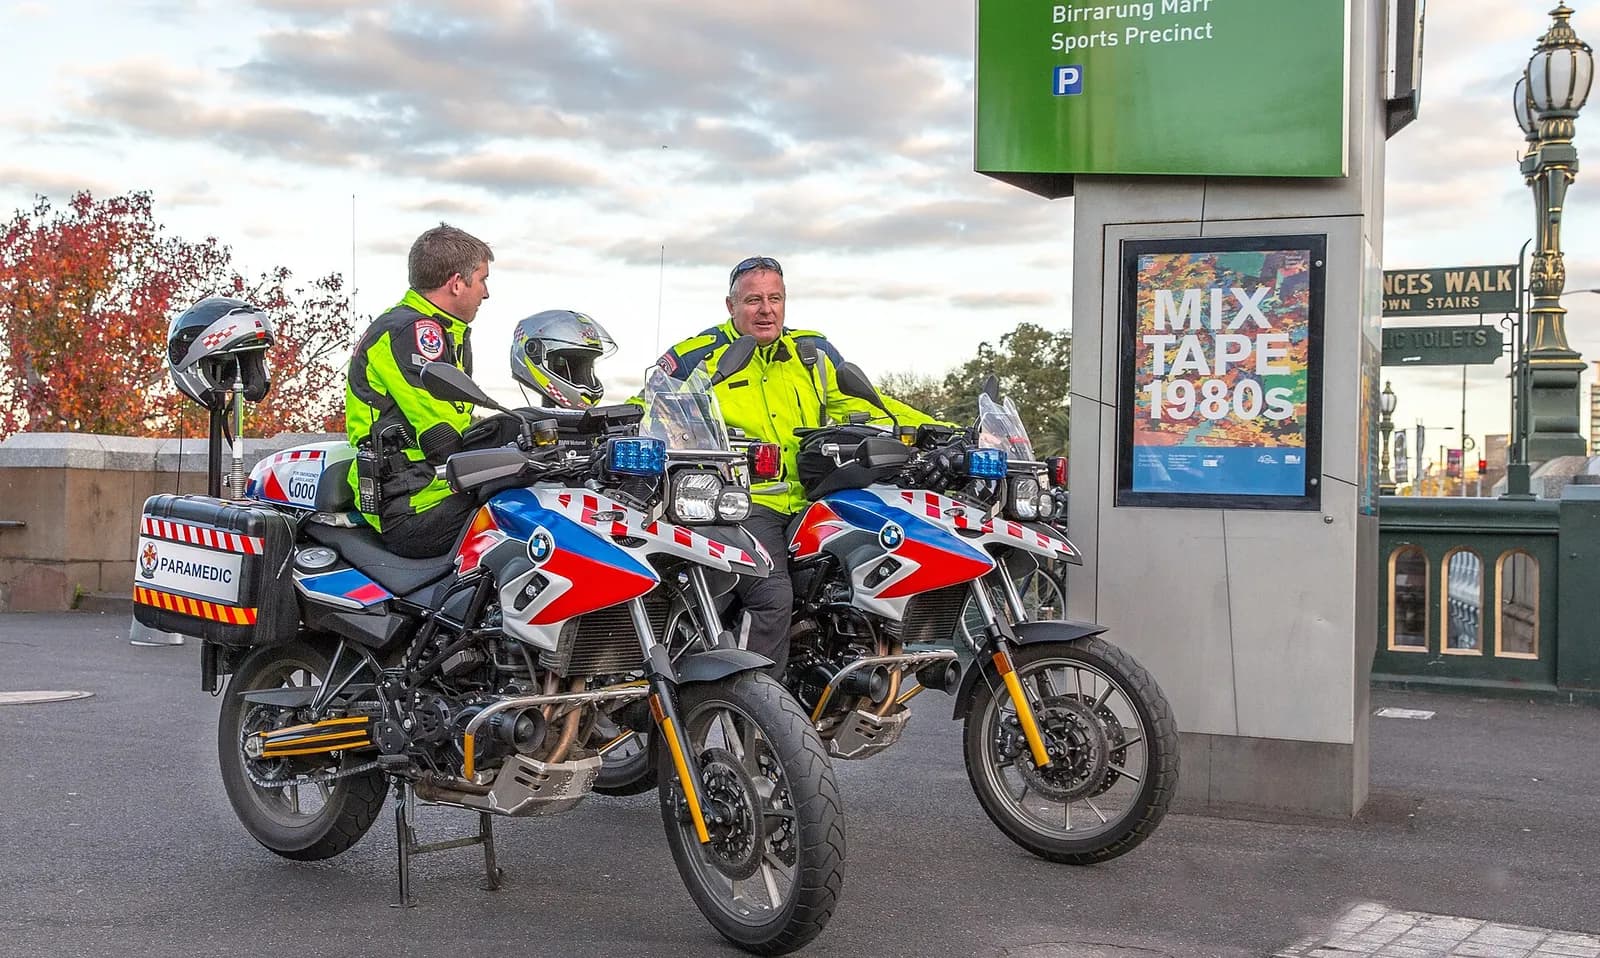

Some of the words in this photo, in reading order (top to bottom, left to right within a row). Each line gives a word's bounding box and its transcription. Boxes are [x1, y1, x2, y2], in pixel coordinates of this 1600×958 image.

[1052, 2, 1153, 24] Birrarung
[1161, 0, 1212, 15] Marr
[1051, 30, 1118, 54] Sports
[1125, 22, 1213, 45] Precinct
[1058, 67, 1079, 94] P
[1445, 269, 1512, 293] WALK
[1154, 286, 1273, 330] MIX
[1426, 296, 1480, 309] STAIRS
[1383, 331, 1406, 348] IC
[1411, 329, 1487, 348] TOILETS
[1143, 333, 1291, 376] TAPE
[1143, 378, 1294, 420] 1980s
[295, 482, 316, 499] 000
[160, 557, 232, 584] PARAMEDIC
